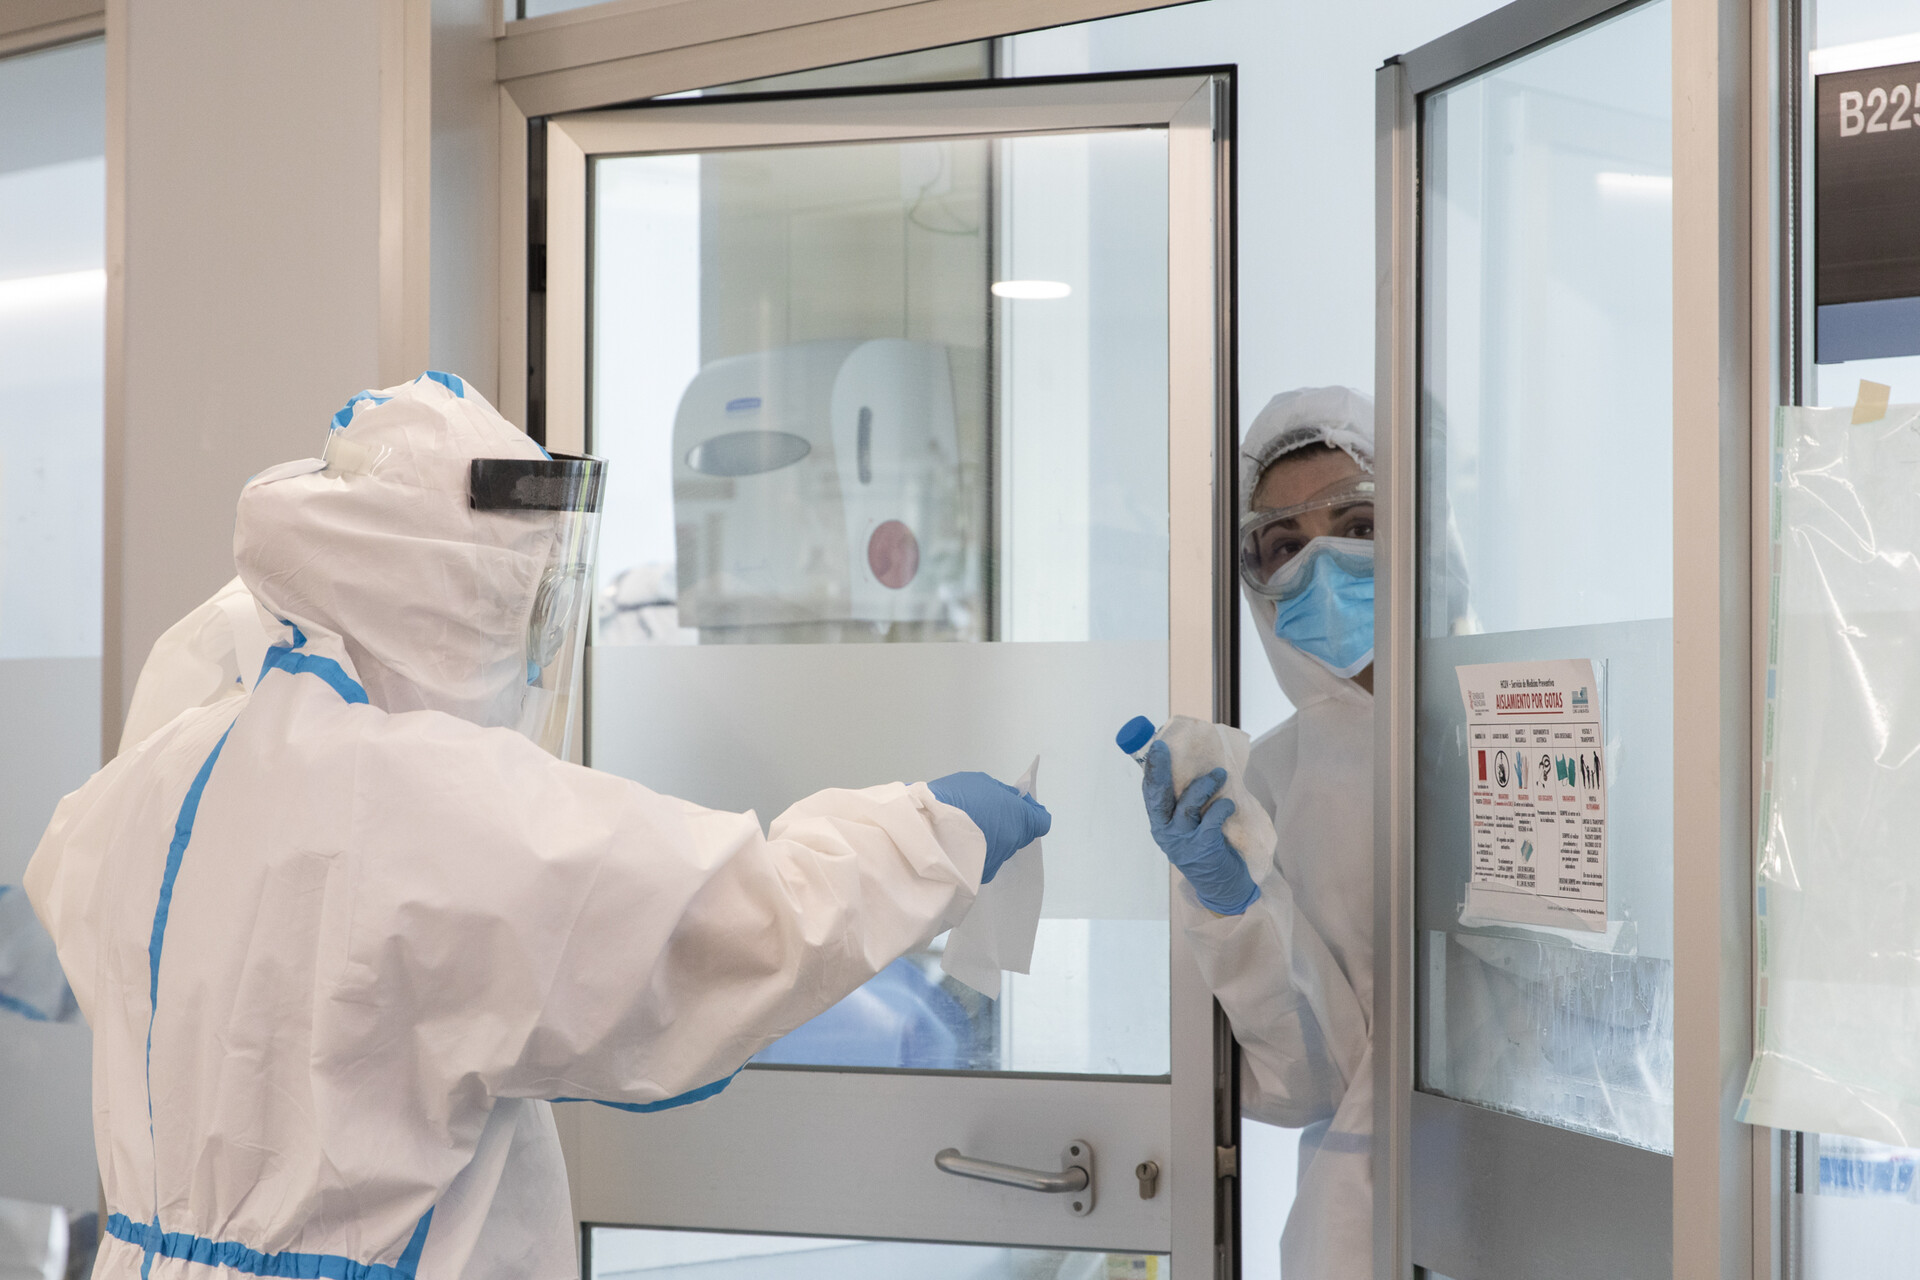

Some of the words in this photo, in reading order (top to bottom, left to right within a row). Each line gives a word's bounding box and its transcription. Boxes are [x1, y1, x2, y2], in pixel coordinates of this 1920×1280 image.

[1496, 693, 1531, 709] AISLAMIENTO
[1531, 692, 1542, 709] POR
[1544, 692, 1563, 708] GOTAS
